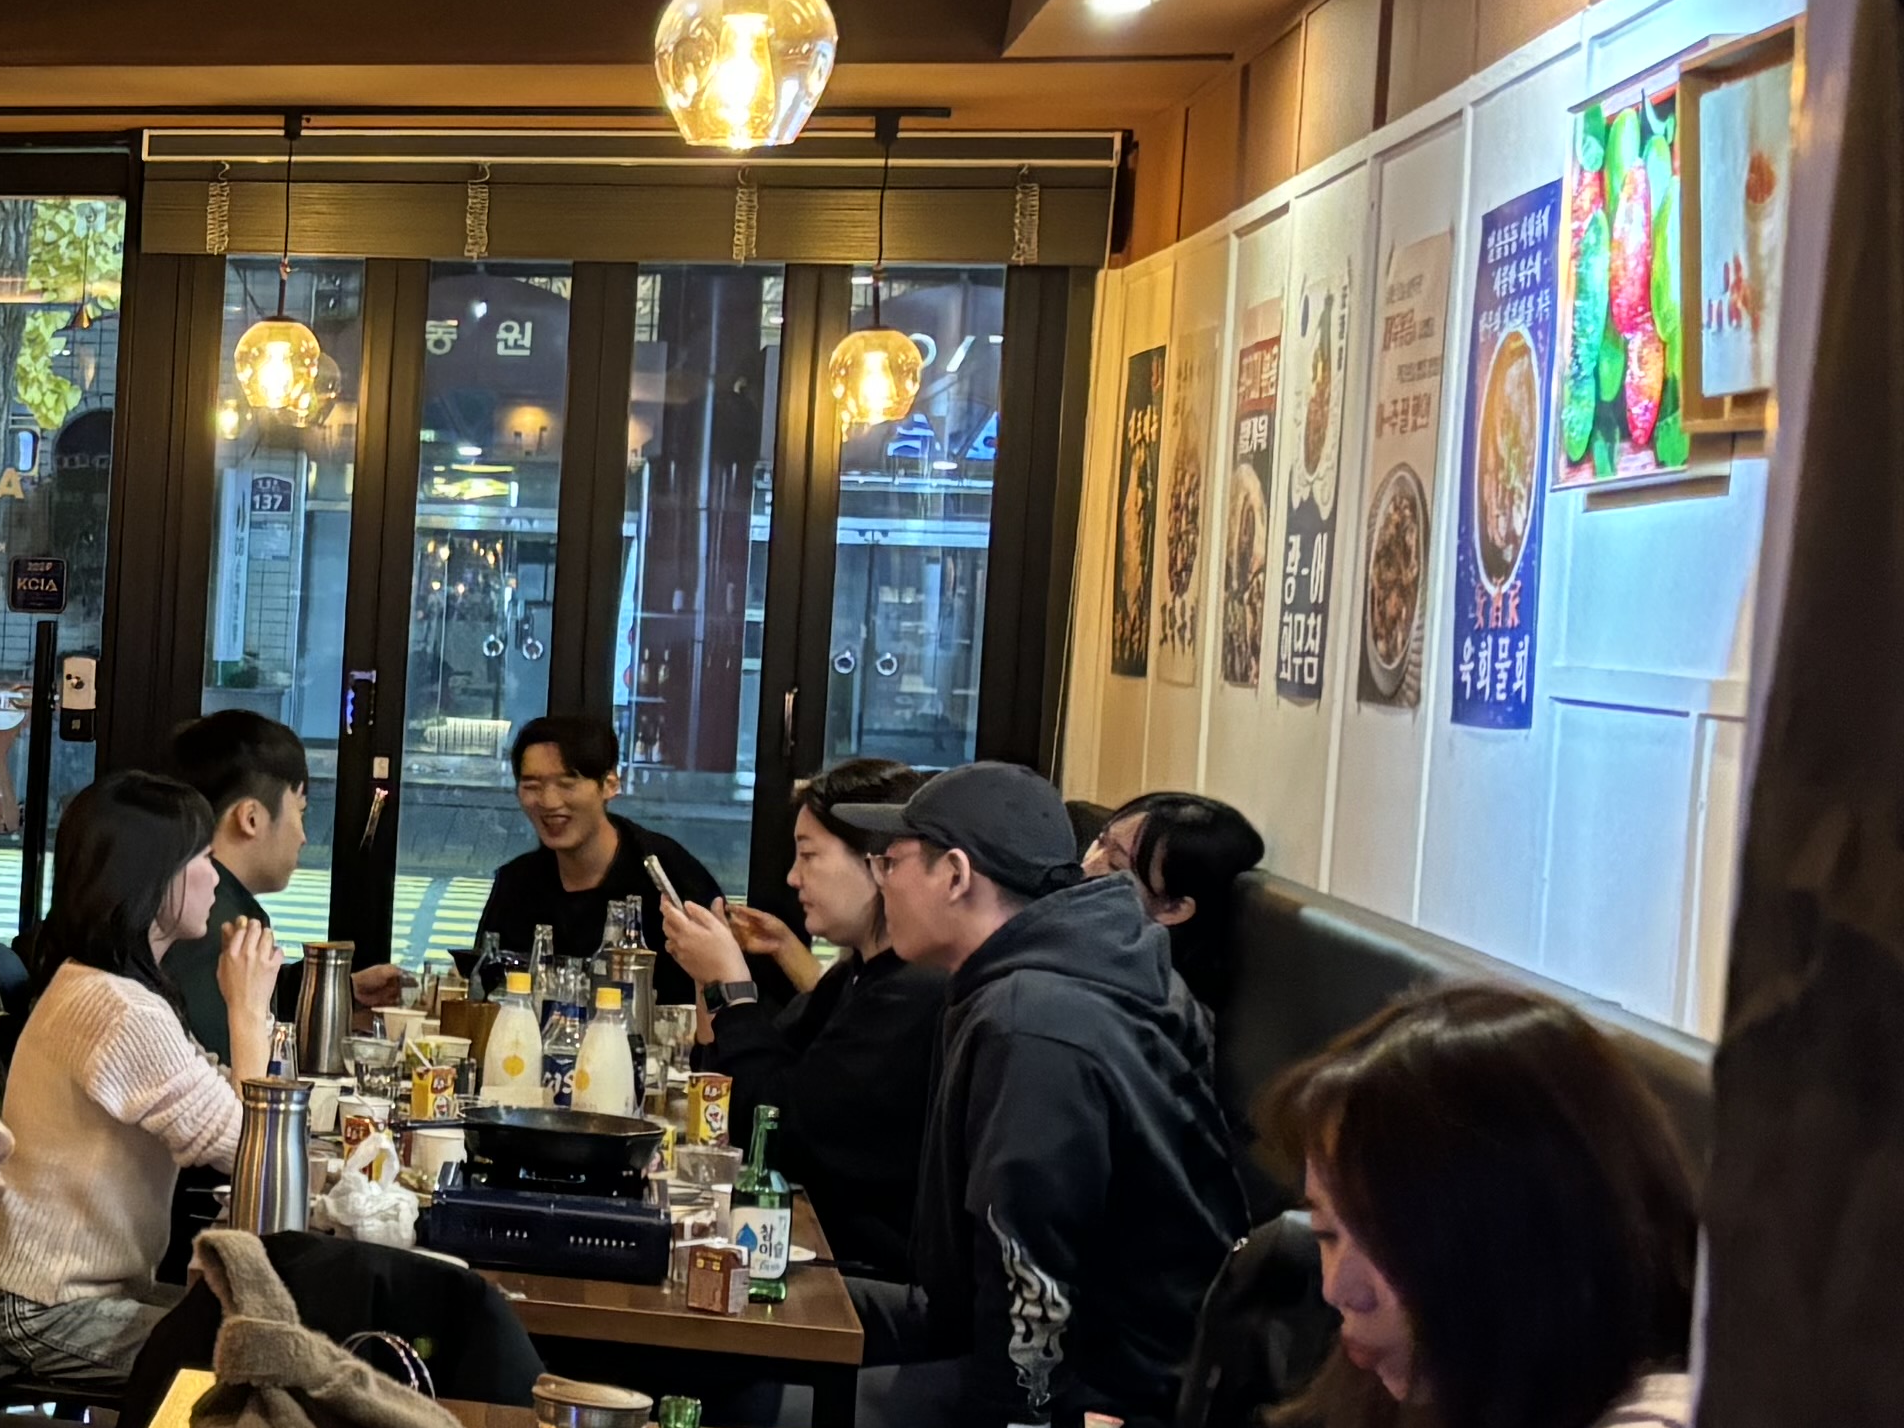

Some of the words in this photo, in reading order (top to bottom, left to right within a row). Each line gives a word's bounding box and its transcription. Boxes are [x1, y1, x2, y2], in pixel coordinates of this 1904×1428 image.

[253, 494, 283, 511] 137
[1278, 609, 1323, 686] 회무침
[1458, 633, 1531, 704] 육회물회
